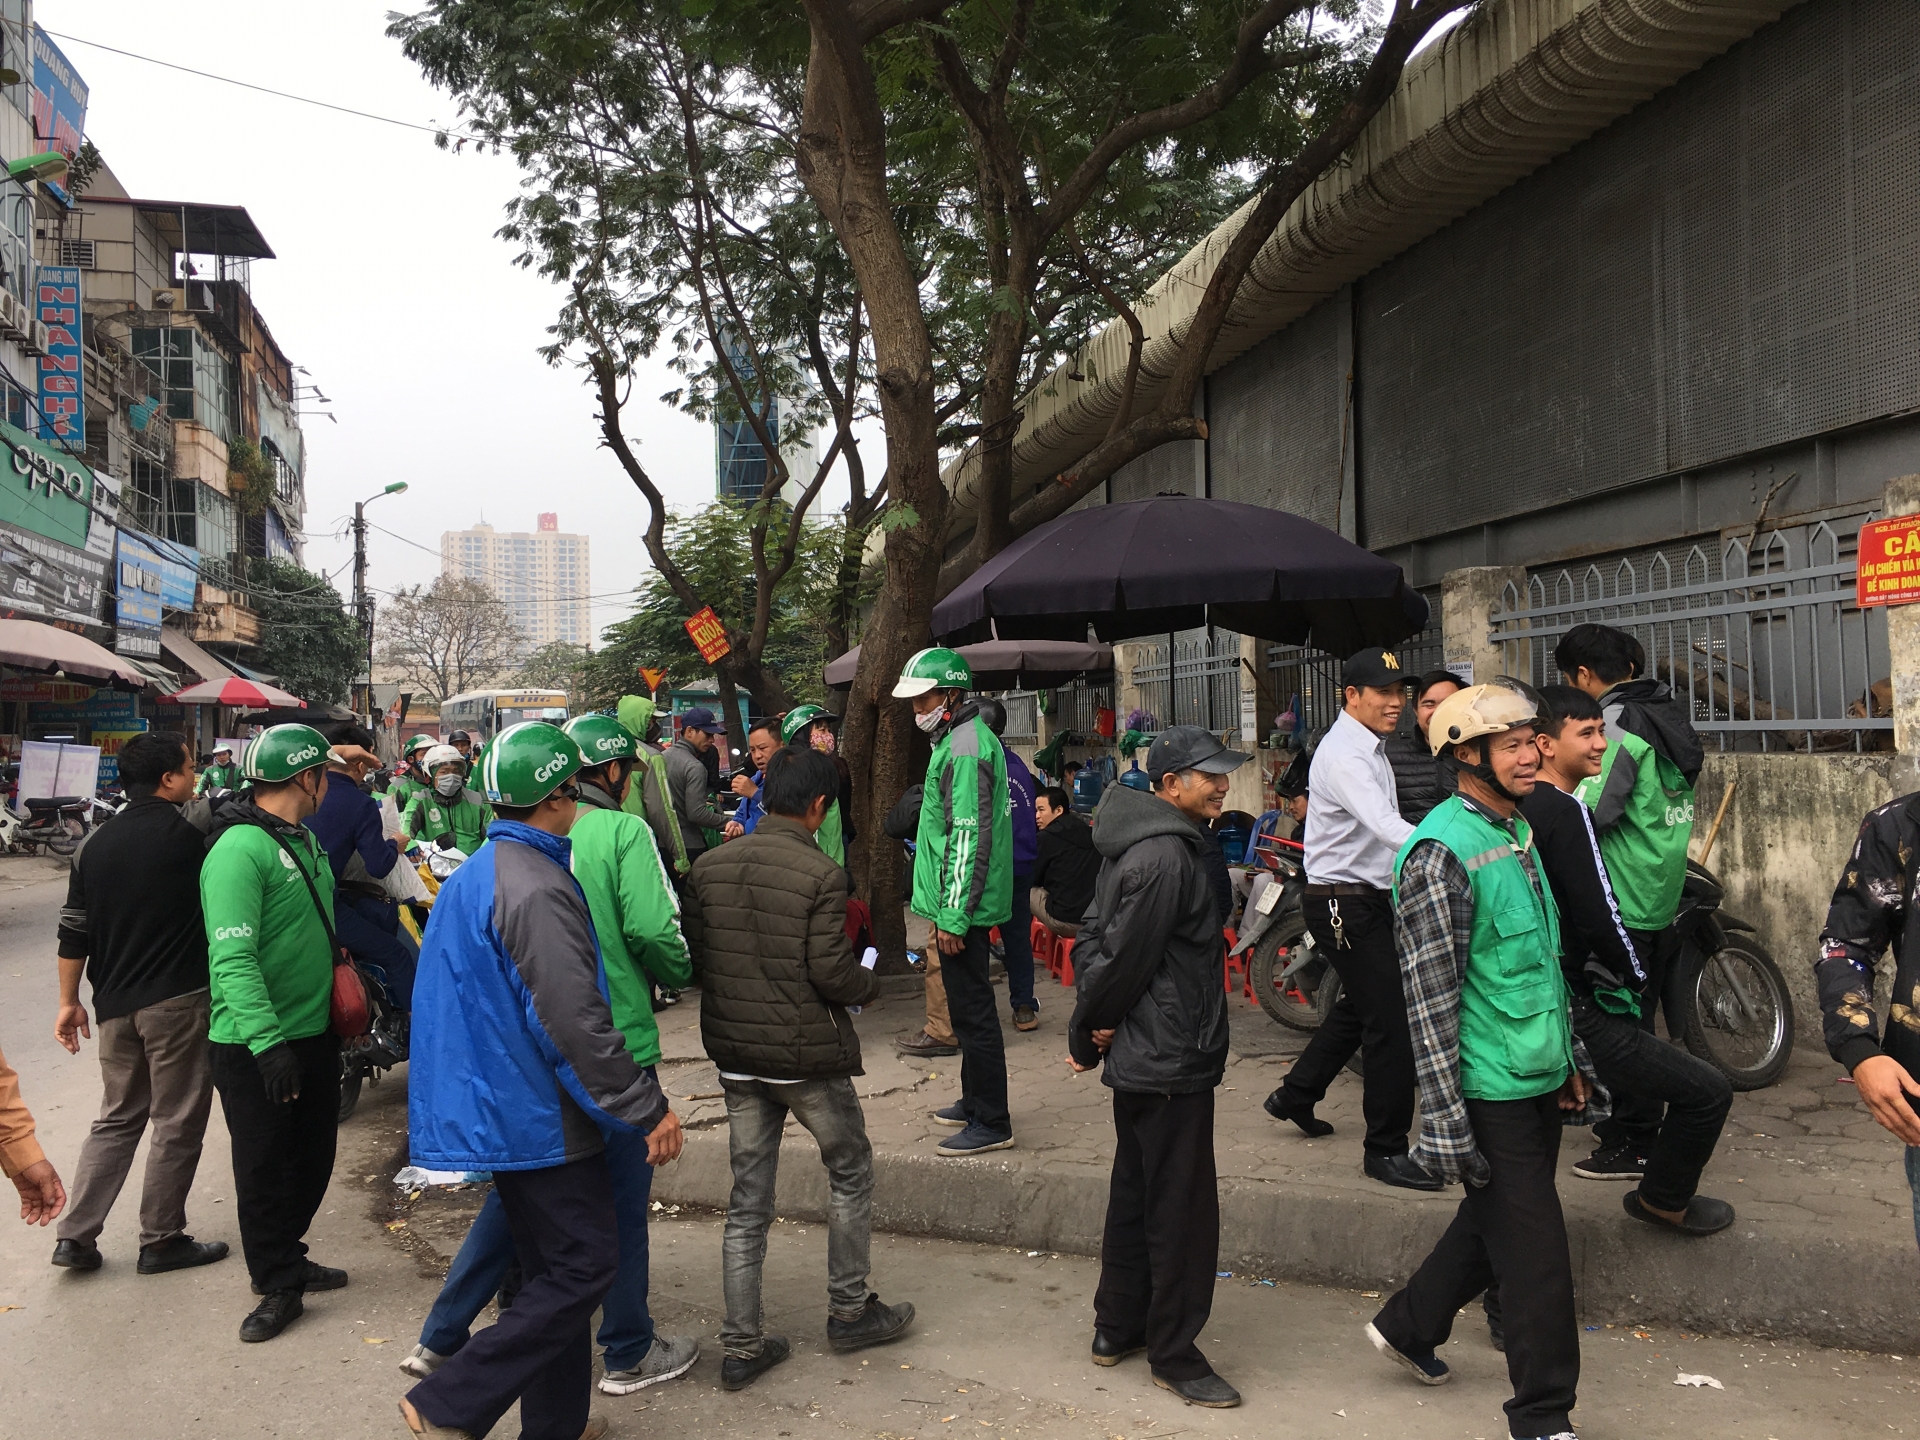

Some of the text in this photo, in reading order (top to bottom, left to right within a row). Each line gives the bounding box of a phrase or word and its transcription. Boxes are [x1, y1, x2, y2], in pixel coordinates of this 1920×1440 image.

[34, 35, 87, 109] QUANG HUY
[63, 270, 78, 284] HUY
[1876, 557, 1901, 576] CHIẾM
[1878, 577, 1900, 592] KINH
[692, 619, 725, 648] KHÓA
[945, 669, 968, 682] Grab
[783, 716, 800, 734] Grab
[595, 733, 628, 751] Grab
[286, 744, 319, 766] Grab
[534, 752, 569, 783] Grab
[954, 815, 977, 826] Grab
[1665, 798, 1695, 827] Gab
[215, 922, 253, 941] Grab
